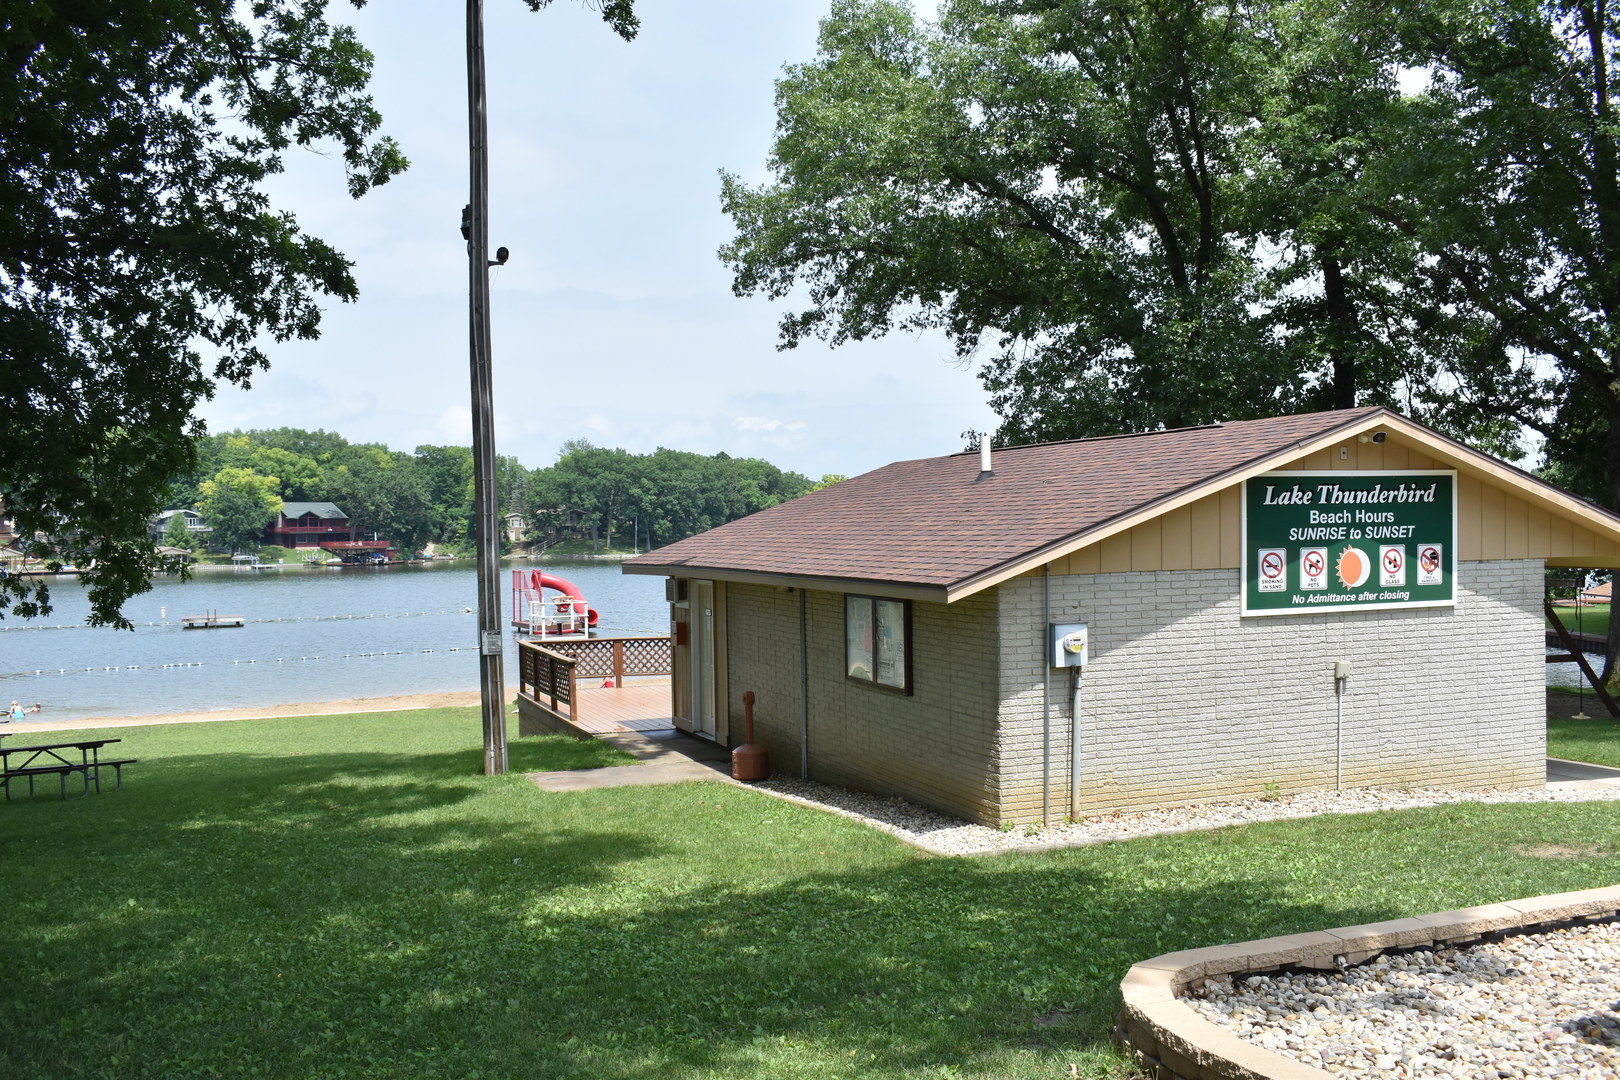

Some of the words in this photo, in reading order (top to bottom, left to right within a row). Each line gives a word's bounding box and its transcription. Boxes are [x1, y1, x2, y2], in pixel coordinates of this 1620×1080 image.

[1263, 484, 1312, 505] Lake
[1317, 483, 1437, 504] Thunderbird
[1309, 510, 1351, 524] Beach
[1355, 509, 1394, 523] Hours
[1289, 527, 1346, 540] SUNRISE
[1349, 528, 1362, 539] to
[1364, 526, 1415, 538] SUNSET
[1292, 594, 1304, 604] No
[1307, 594, 1356, 603] Admittance
[1358, 592, 1378, 601] after
[1380, 590, 1410, 600] closing
